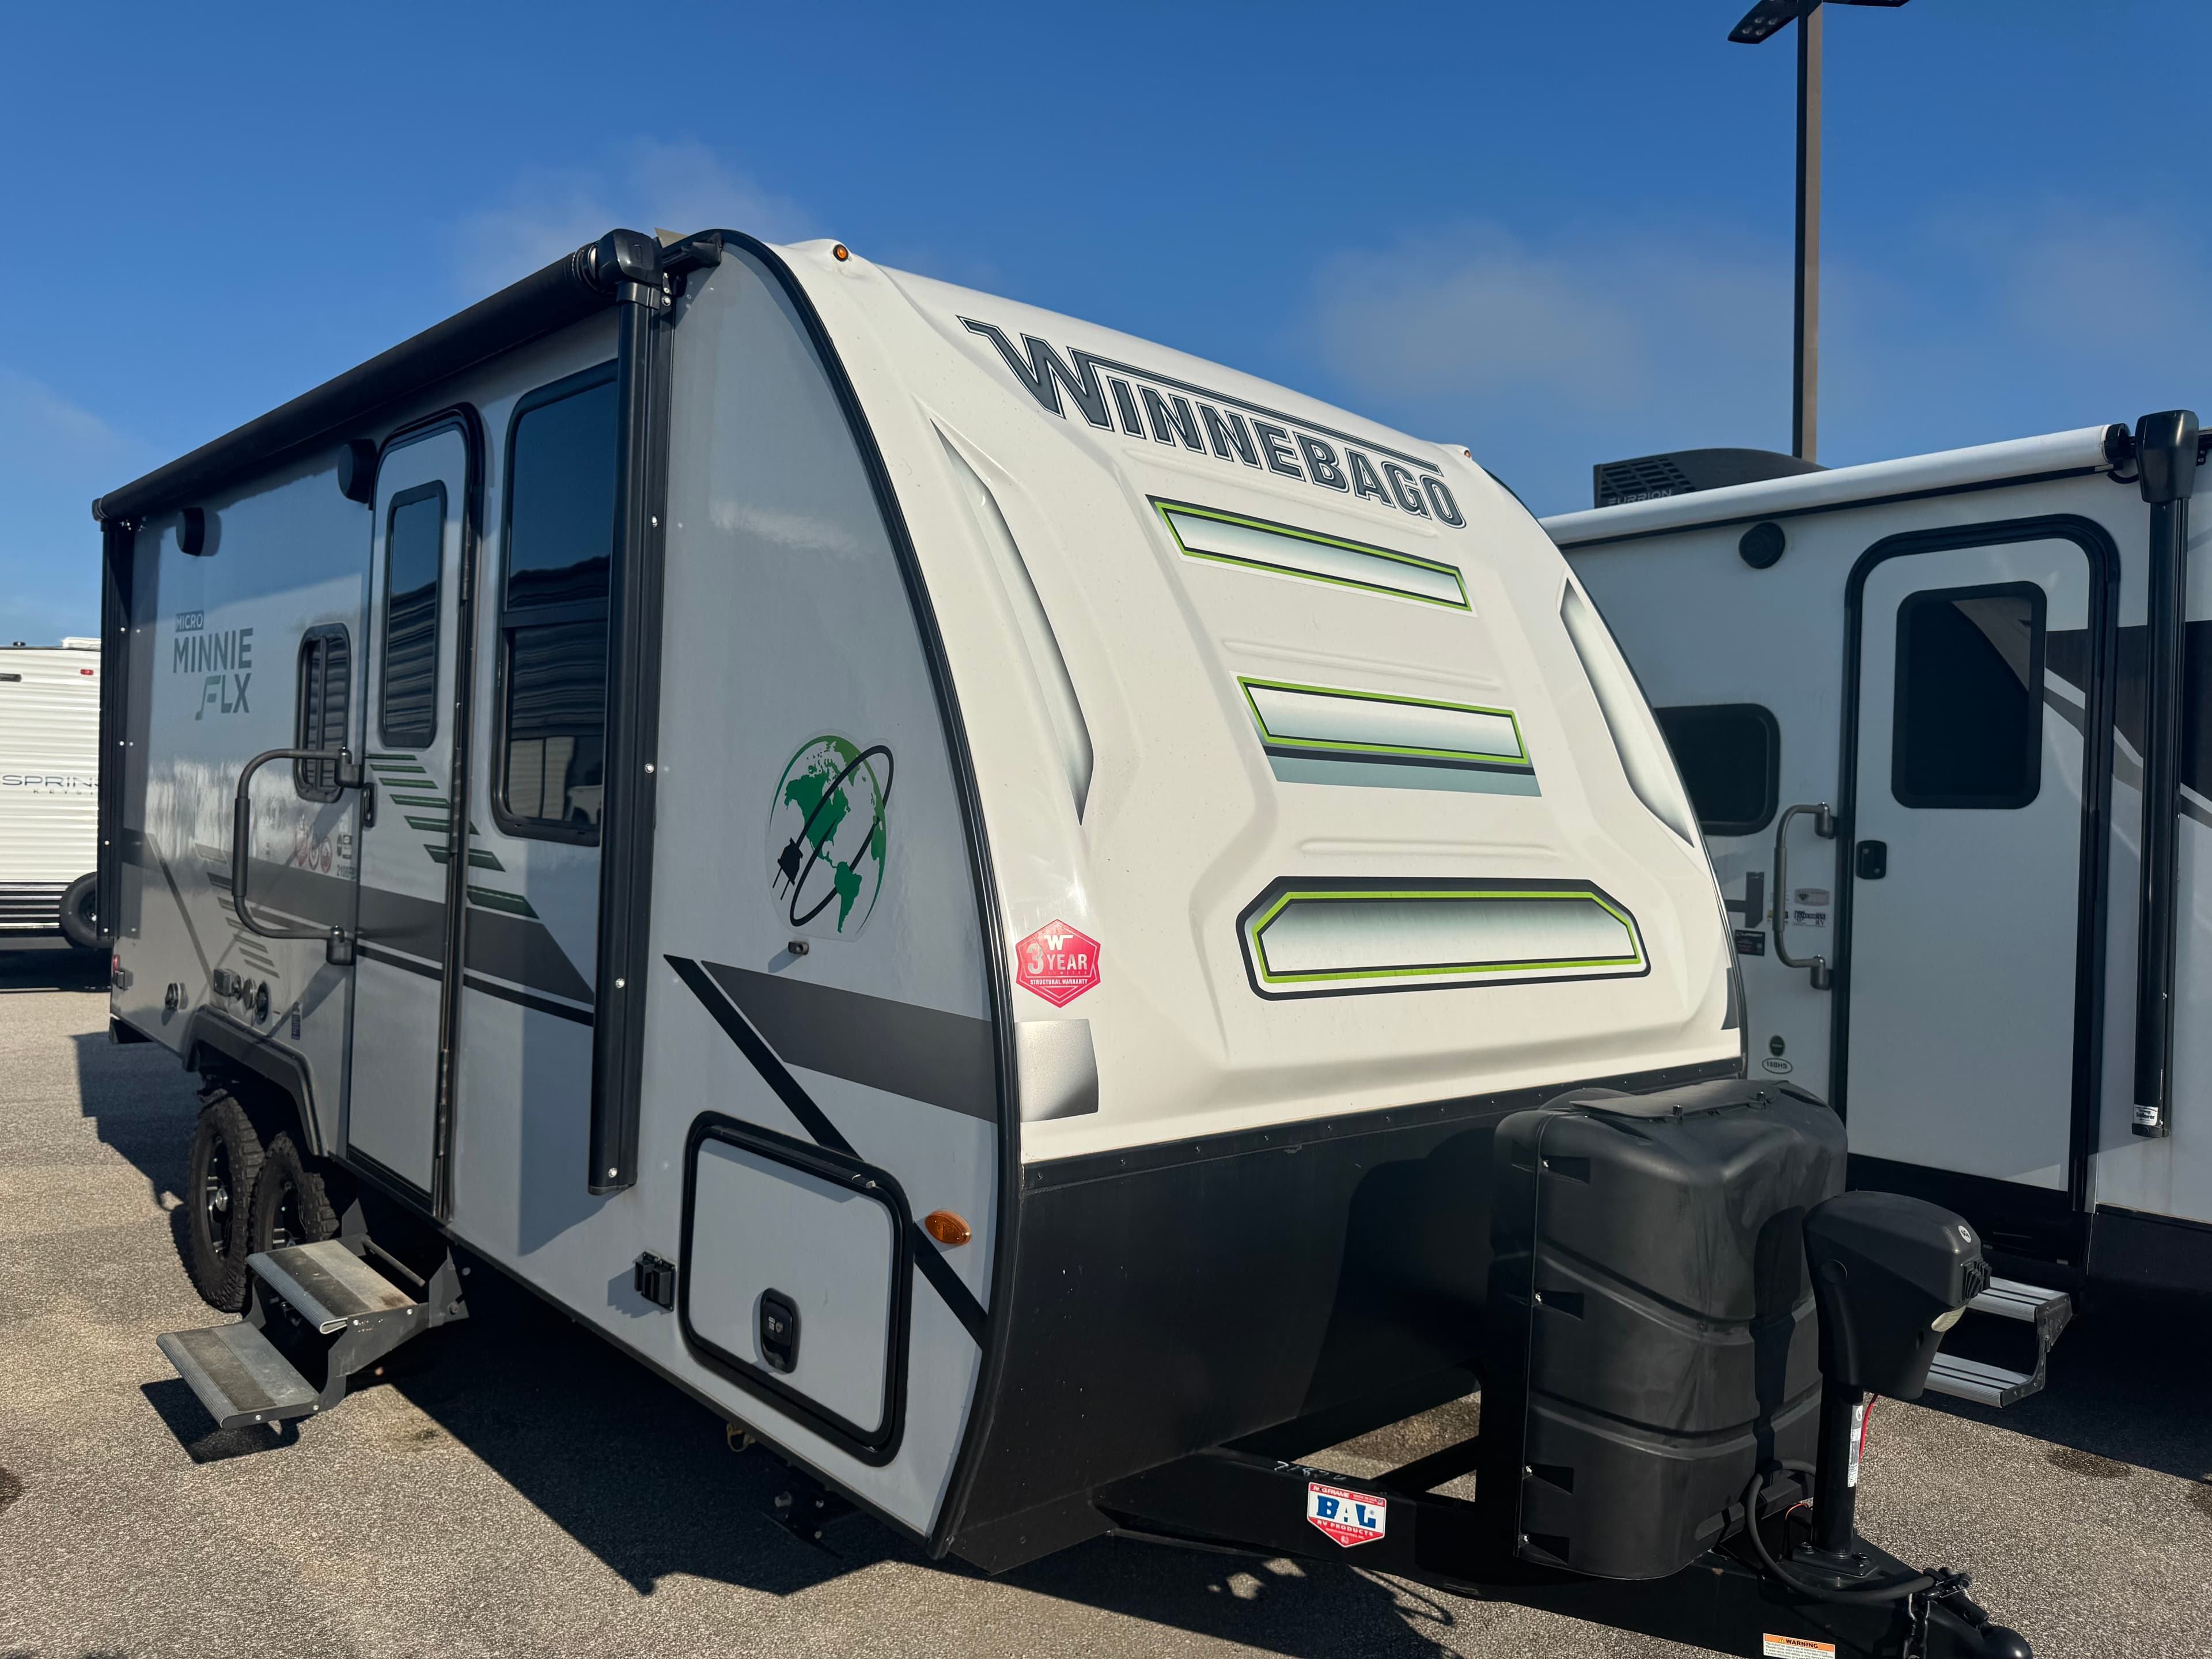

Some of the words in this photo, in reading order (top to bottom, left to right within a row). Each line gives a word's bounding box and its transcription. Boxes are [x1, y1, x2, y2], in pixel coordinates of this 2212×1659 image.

[956, 315, 1467, 529] WINNEBAGO
[176, 613, 204, 630] MICRO
[173, 627, 253, 673] MINNIE
[195, 672, 251, 721] FLX
[2, 775, 99, 787] SPRIN
[1027, 942, 1044, 975] 3
[1047, 954, 1088, 970] YEAR
[1316, 1495, 1377, 1529] BAL
[1330, 1522, 1373, 1537] PRODUCTS
[1785, 1638, 1818, 1648] WARNING
